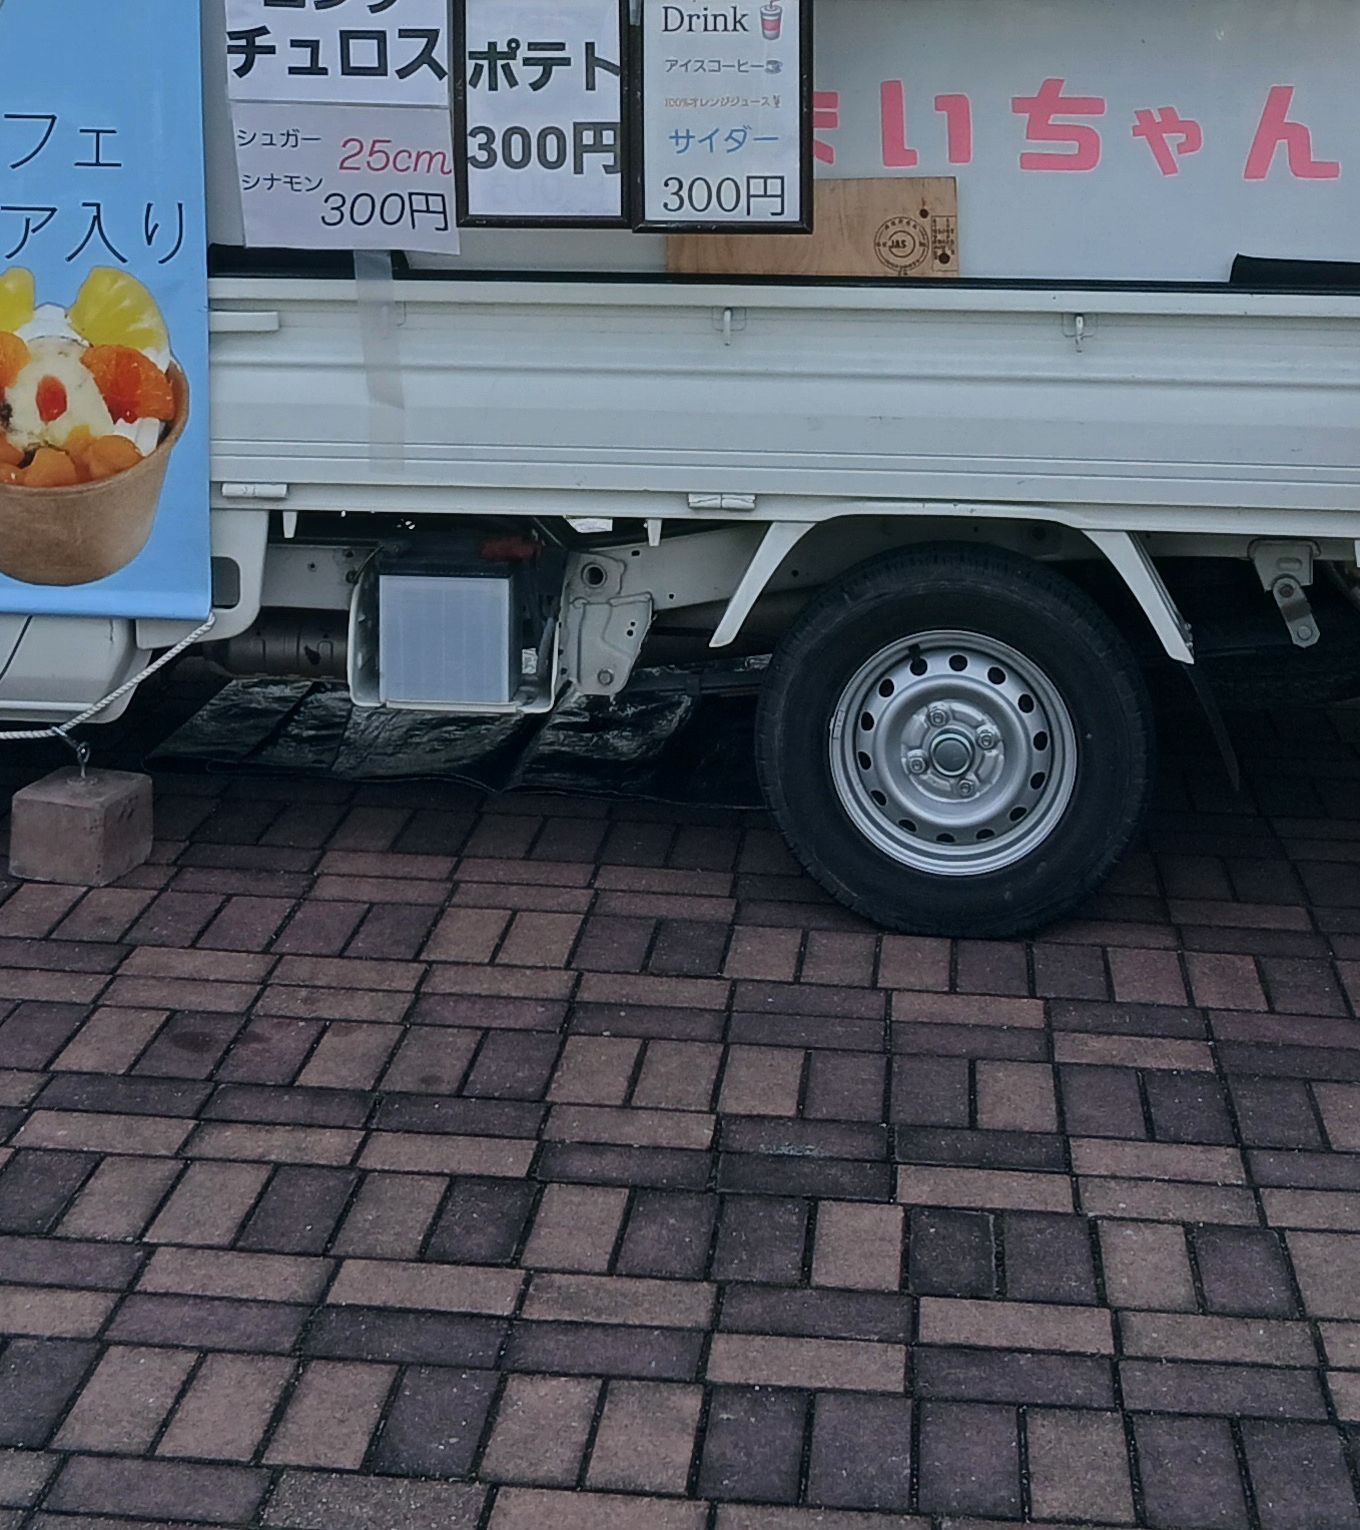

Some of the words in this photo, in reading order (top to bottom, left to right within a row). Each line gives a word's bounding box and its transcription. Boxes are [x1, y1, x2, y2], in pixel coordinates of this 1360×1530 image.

[661, 5, 749, 34] Drink
[226, 25, 448, 81] チュロス
[468, 38, 620, 92] ポテト
[665, 59, 764, 73] アイスコーヒー
[237, 128, 321, 149] シュガー
[339, 137, 452, 175] 25cm
[466, 121, 620, 174] 300円
[669, 125, 779, 155] サイダー
[242, 173, 323, 194] シナモン
[662, 175, 785, 217] 300円
[321, 191, 448, 231] 300円
